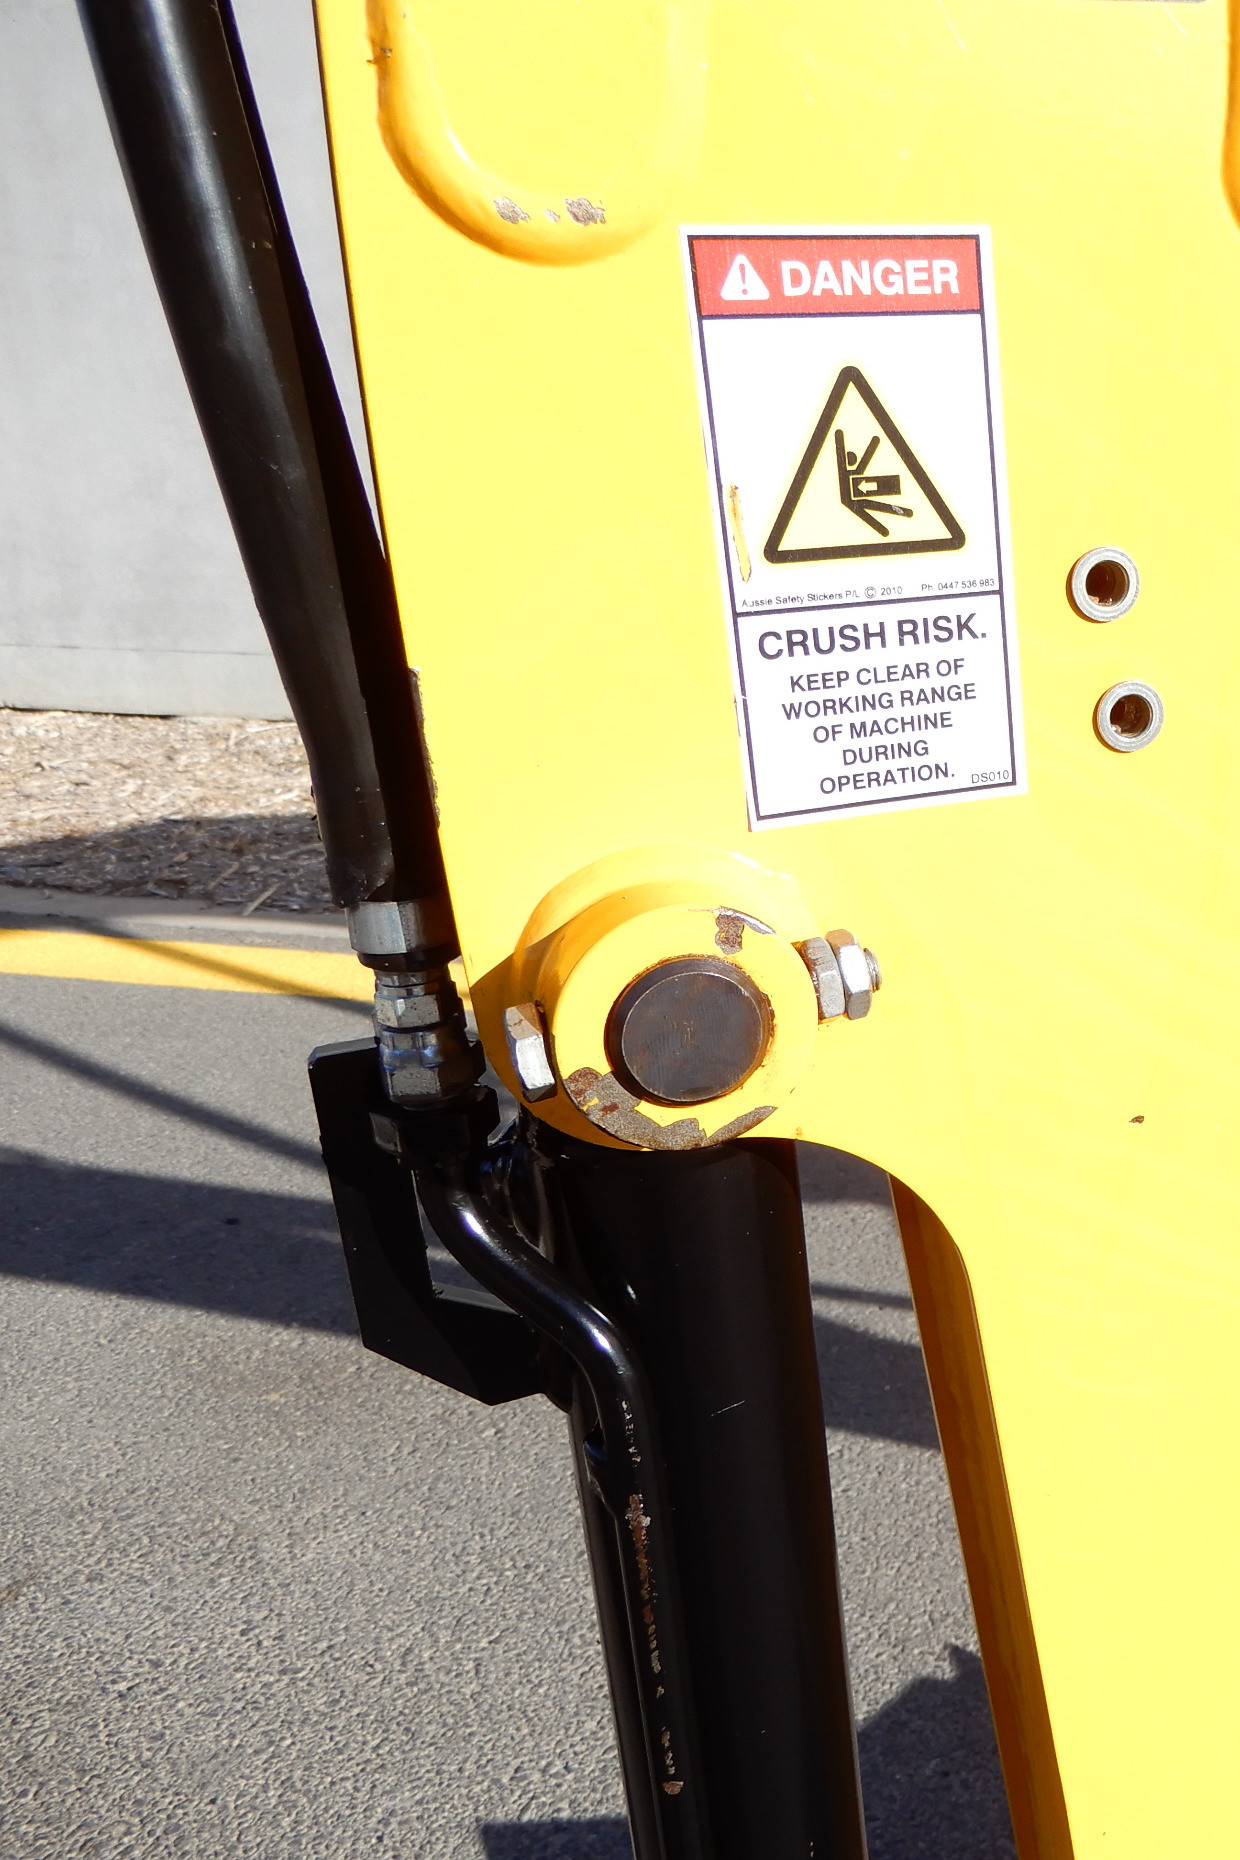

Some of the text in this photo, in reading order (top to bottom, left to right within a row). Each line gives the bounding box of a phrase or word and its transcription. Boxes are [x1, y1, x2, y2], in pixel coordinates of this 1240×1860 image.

[781, 259, 960, 297] DANGER
[742, 597, 773, 607] Aussie
[775, 595, 804, 605] Safety
[807, 591, 842, 602] Stickers
[845, 589, 860, 600] P/L
[880, 585, 903, 597] 2010
[937, 580, 960, 591] 0447
[961, 579, 978, 589] 536
[979, 578, 995, 588] 983
[758, 613, 987, 660] CRUSH RISK.
[790, 658, 965, 693] KEEP CLEAR OF
[782, 683, 977, 721] WORKING RANGE
[813, 711, 953, 744] OF MACHINE
[842, 739, 930, 766] DURING
[819, 762, 955, 795] OPERATION.
[971, 770, 1010, 784] DS010
